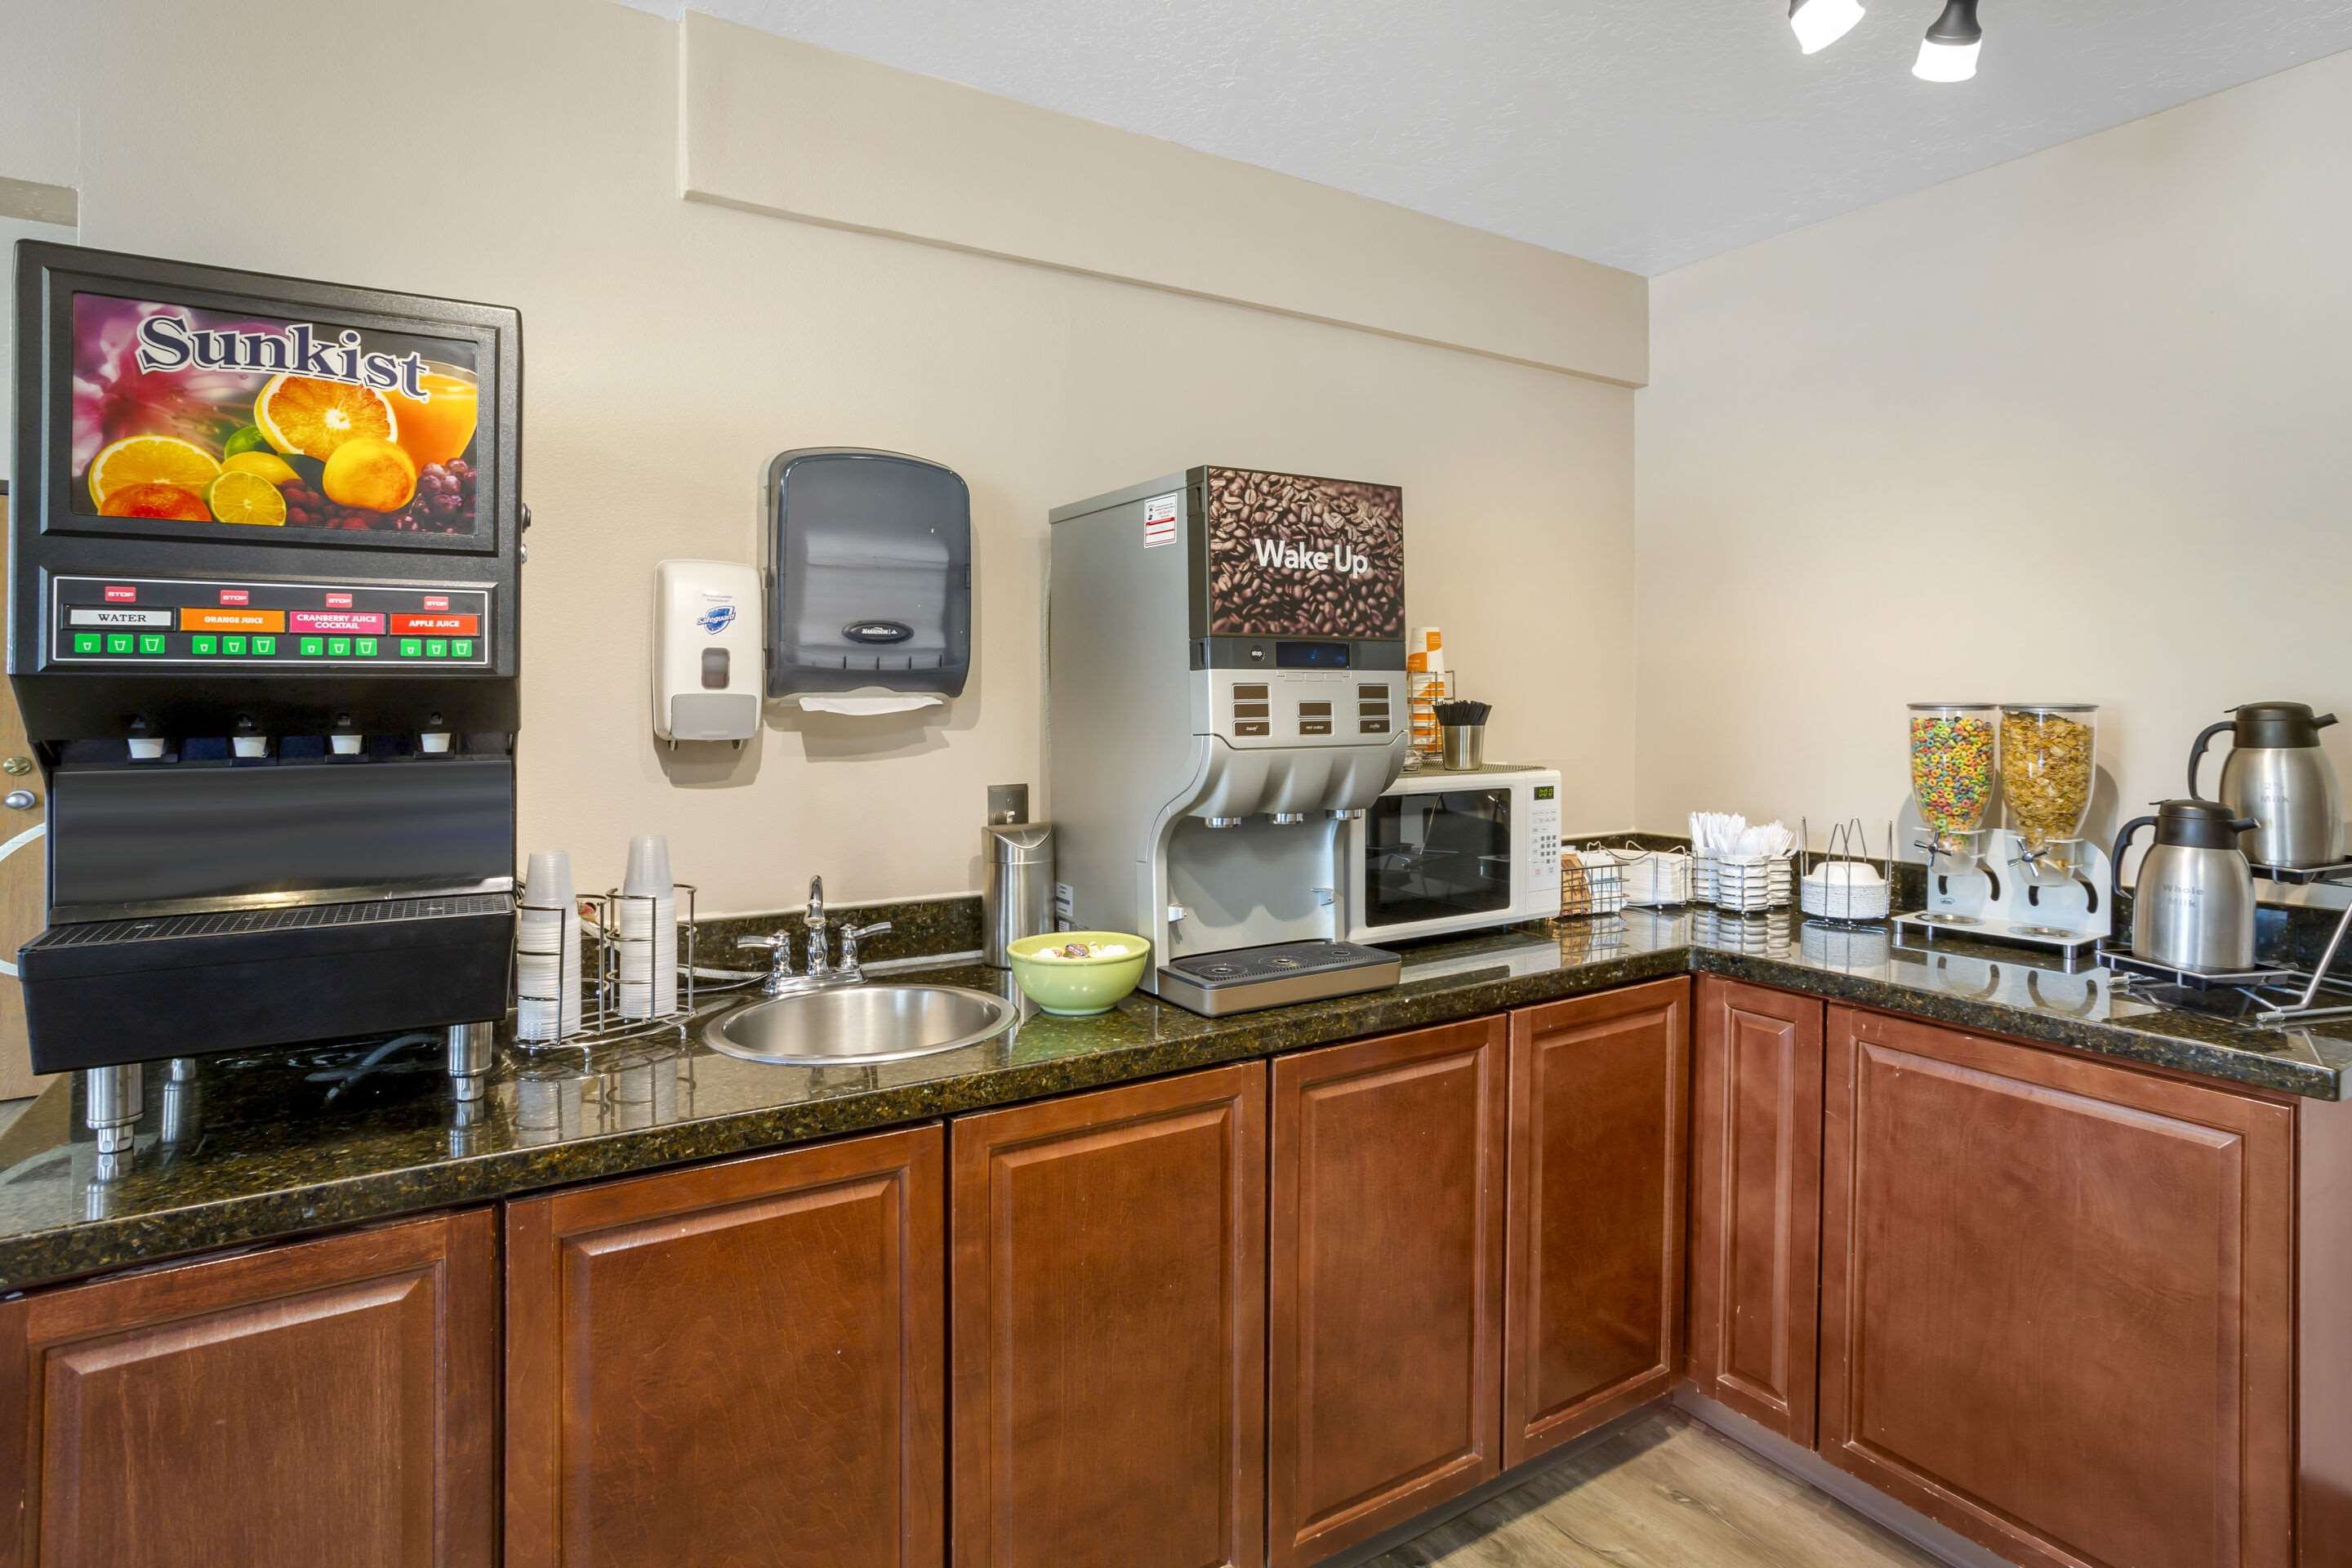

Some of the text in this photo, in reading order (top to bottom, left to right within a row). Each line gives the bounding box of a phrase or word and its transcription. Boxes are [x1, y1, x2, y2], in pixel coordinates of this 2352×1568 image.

[136, 314, 431, 403] Sunkist
[1254, 538, 1369, 579] Wake Up
[98, 613, 147, 622] WATER
[296, 613, 350, 621] CRANBERRY
[697, 612, 736, 626] Safeguard
[435, 620, 460, 628] JUICE
[2163, 883, 2204, 896] Whole
